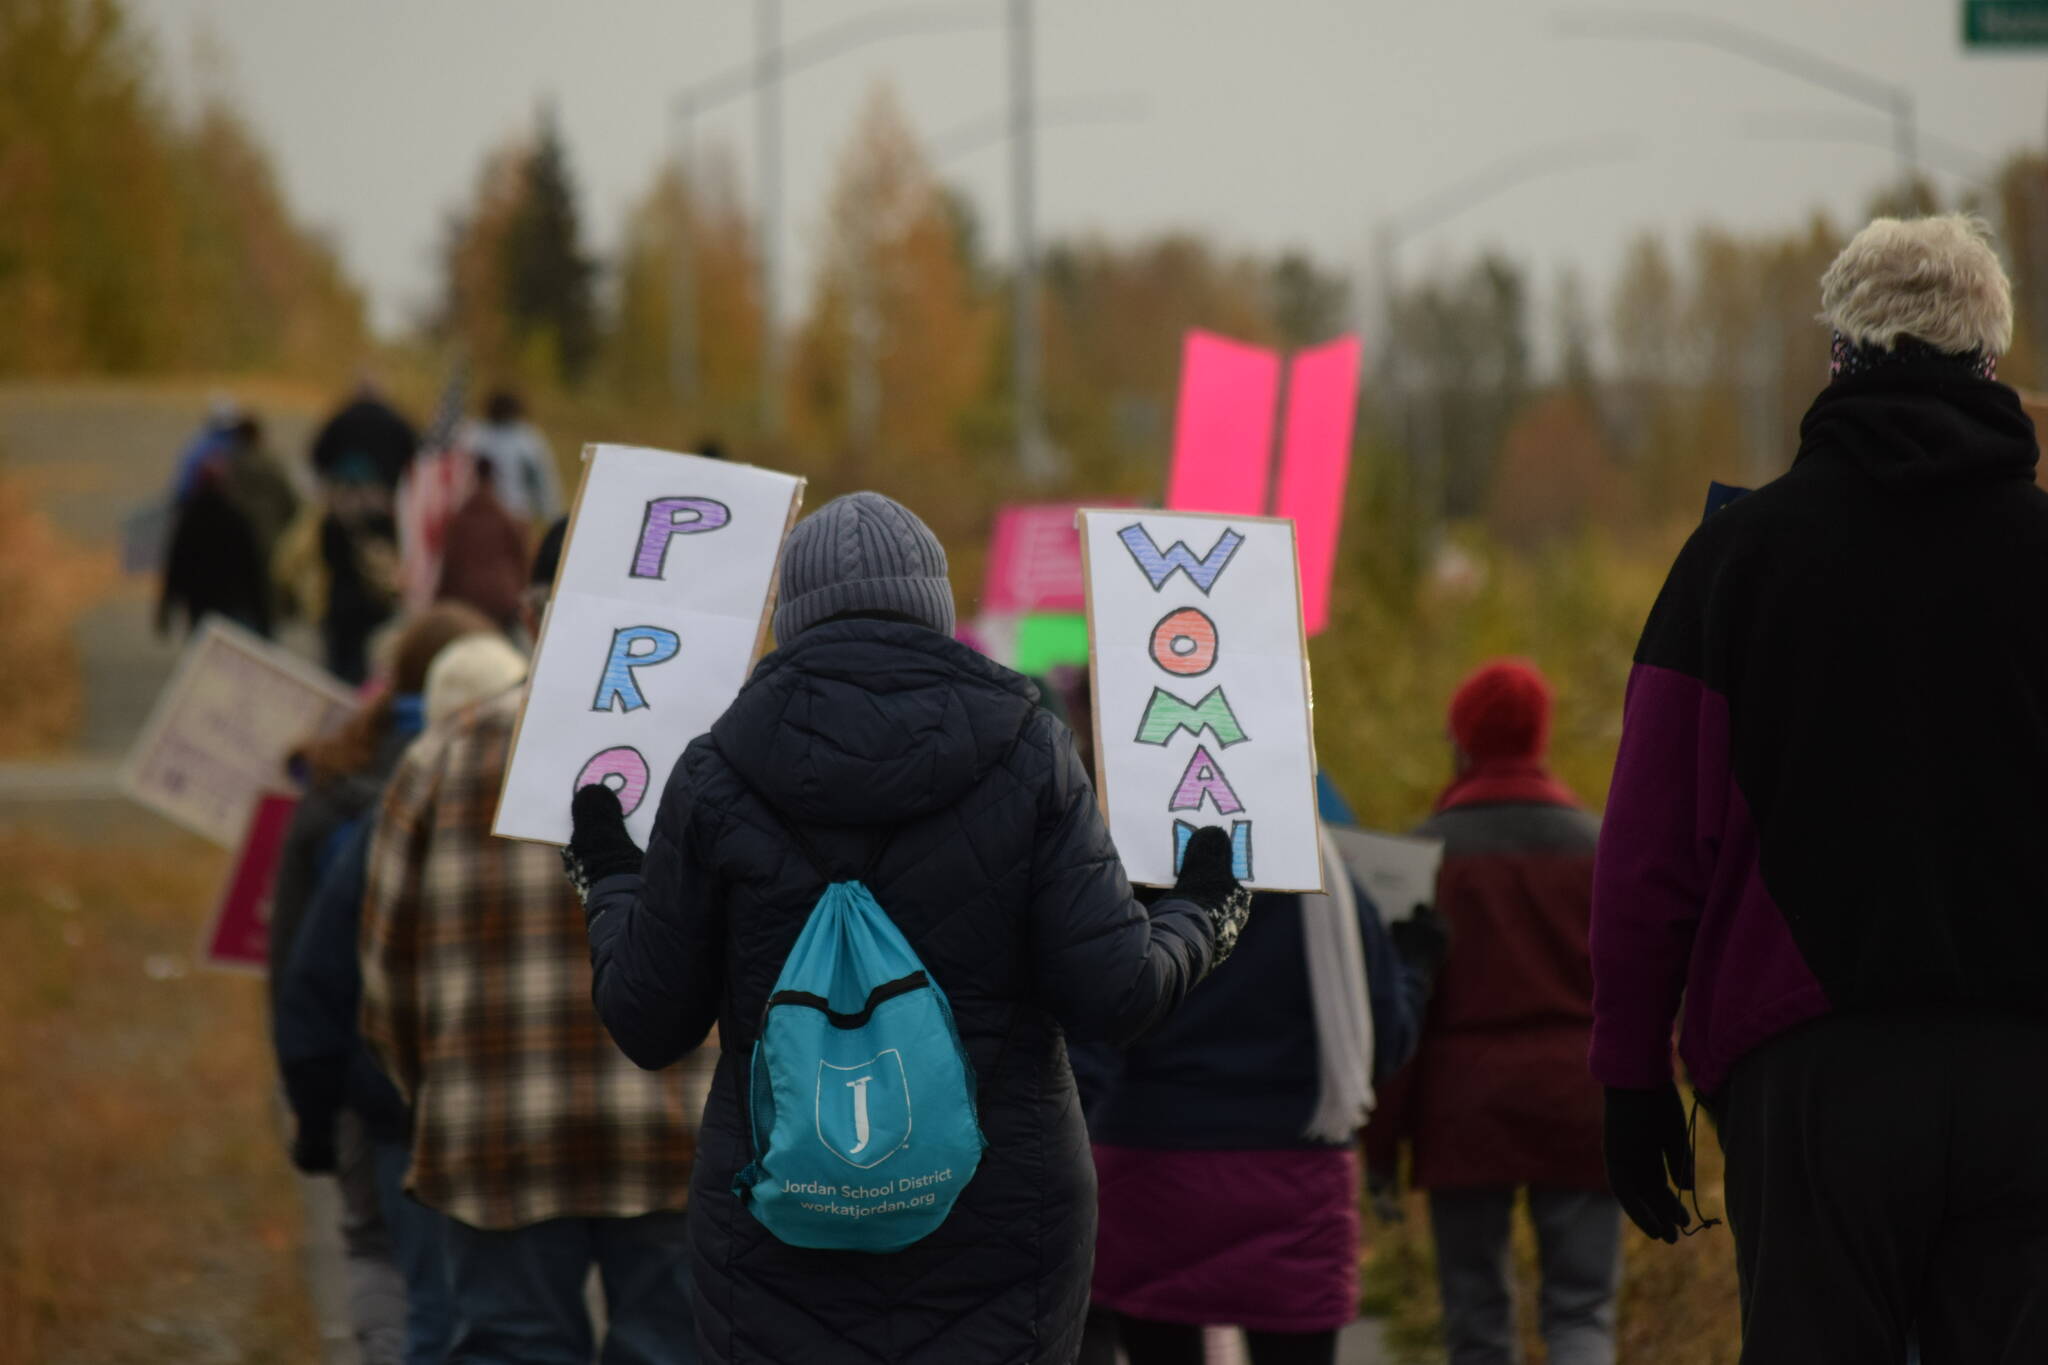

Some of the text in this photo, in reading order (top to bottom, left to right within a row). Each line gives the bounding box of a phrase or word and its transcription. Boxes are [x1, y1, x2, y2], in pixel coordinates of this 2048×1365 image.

[573, 496, 731, 819] PRO
[845, 1076, 873, 1154] J
[782, 1168, 953, 1199] Jordan School District
[800, 1191, 936, 1219] workatjordan.org
